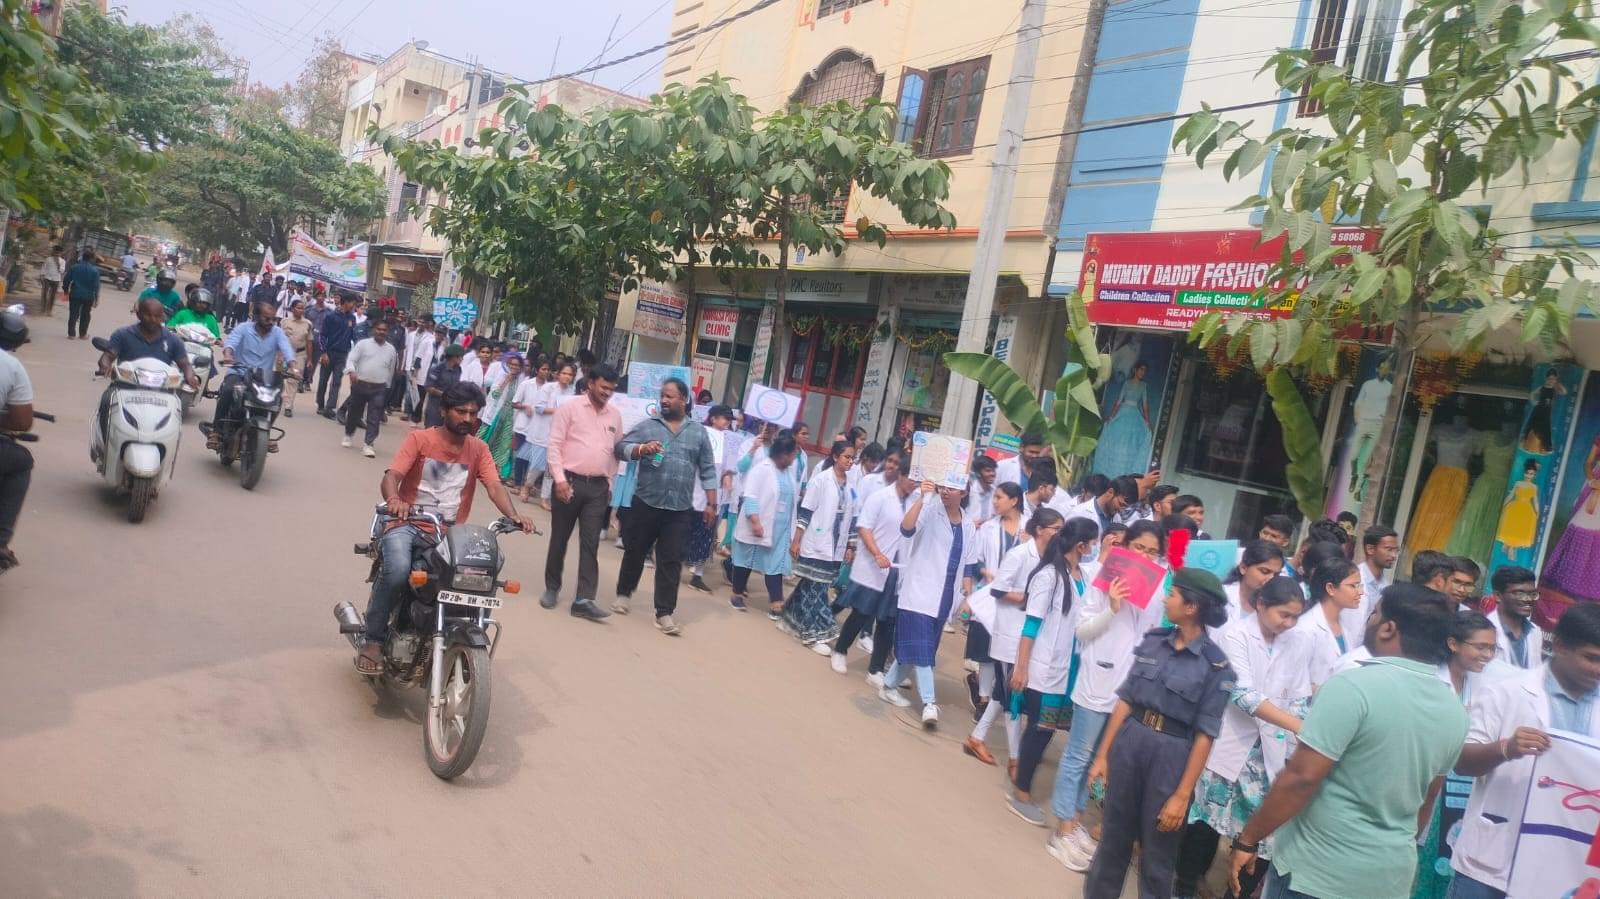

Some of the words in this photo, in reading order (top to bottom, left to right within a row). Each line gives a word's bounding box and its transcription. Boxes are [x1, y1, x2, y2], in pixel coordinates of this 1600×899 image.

[1101, 264, 1153, 285] MUMMY
[1153, 265, 1201, 286] DADDY
[1099, 290, 1130, 302] Children
[1131, 291, 1170, 304] Collection
[1182, 292, 1212, 305] Ladies
[1213, 294, 1259, 307] Collectin
[1166, 308, 1232, 320] READYME
[705, 322, 731, 337] CLINIC
